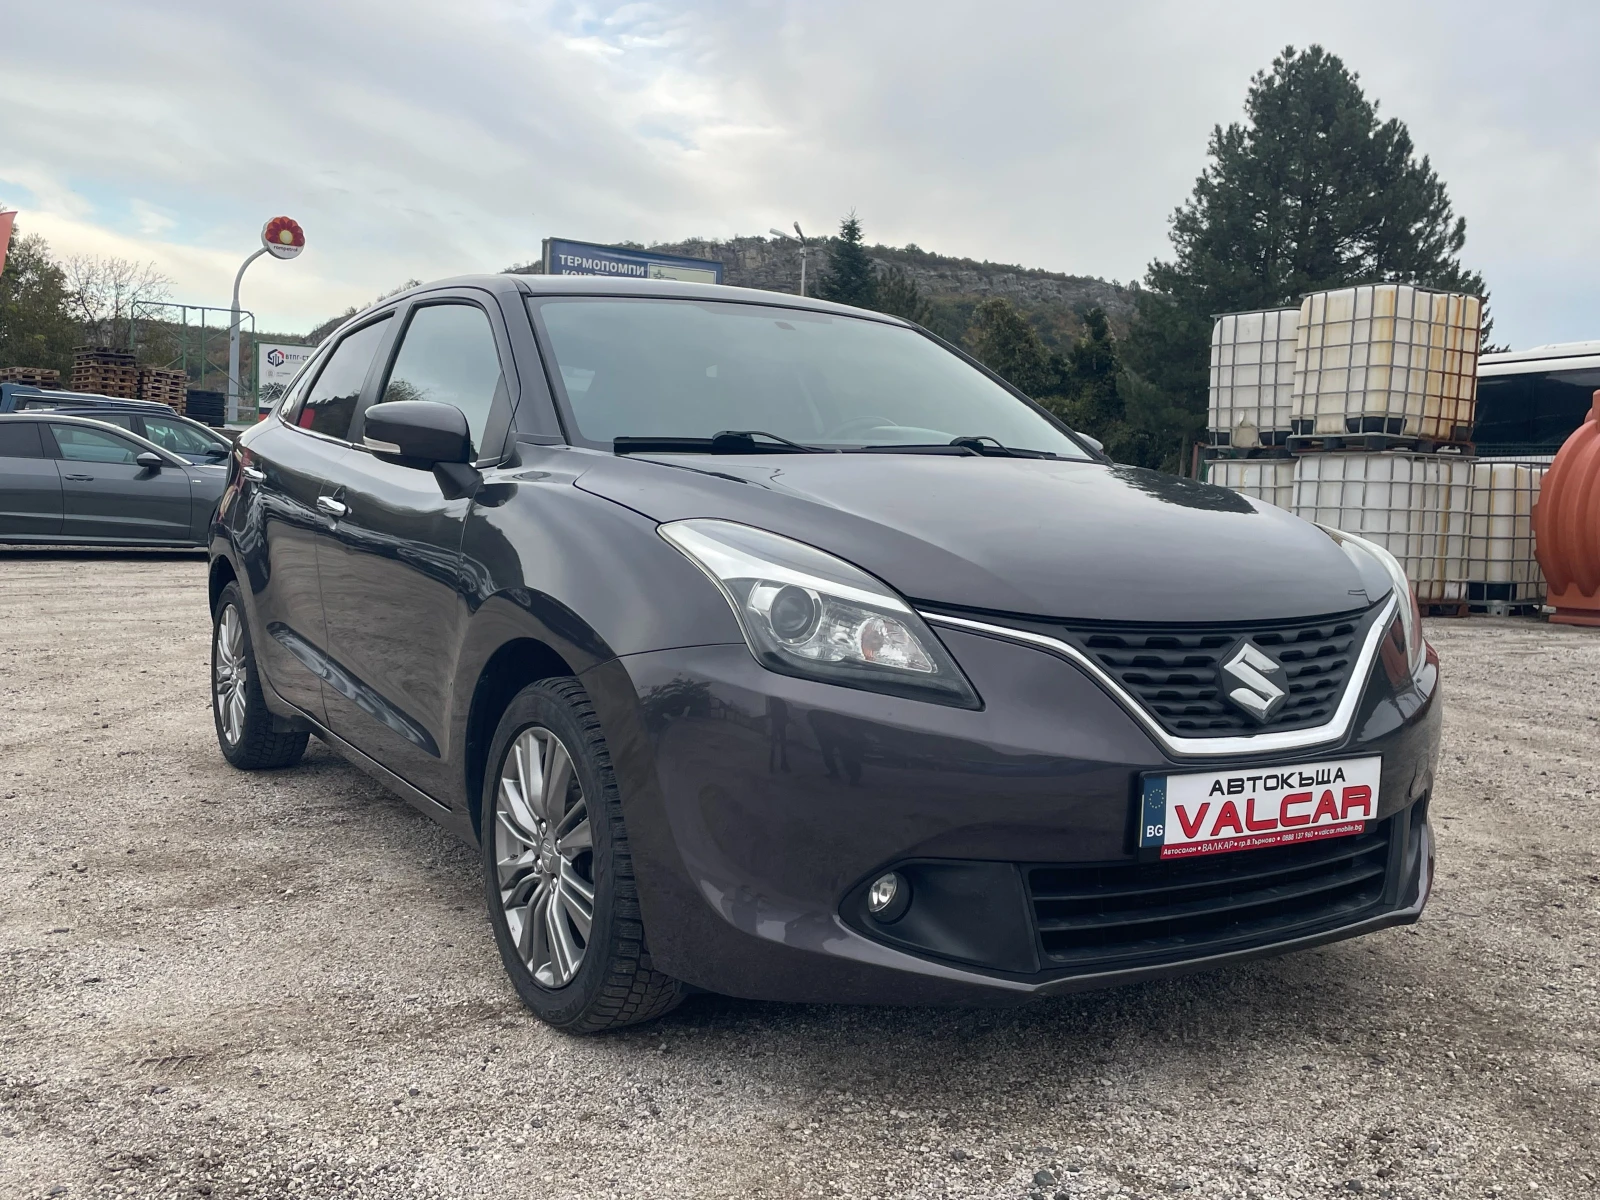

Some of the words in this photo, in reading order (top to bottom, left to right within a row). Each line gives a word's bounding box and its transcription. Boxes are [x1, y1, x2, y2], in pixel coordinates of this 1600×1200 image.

[559, 254, 644, 276] ТЕРМОПОМПИ
[1174, 785, 1372, 839] VALCAR
[1146, 825, 1164, 838] BG
[1163, 847, 1197, 855] Автосалон
[1202, 840, 1234, 852] ВАЛКАР
[1318, 824, 1363, 836] valcar.mobile.bg
